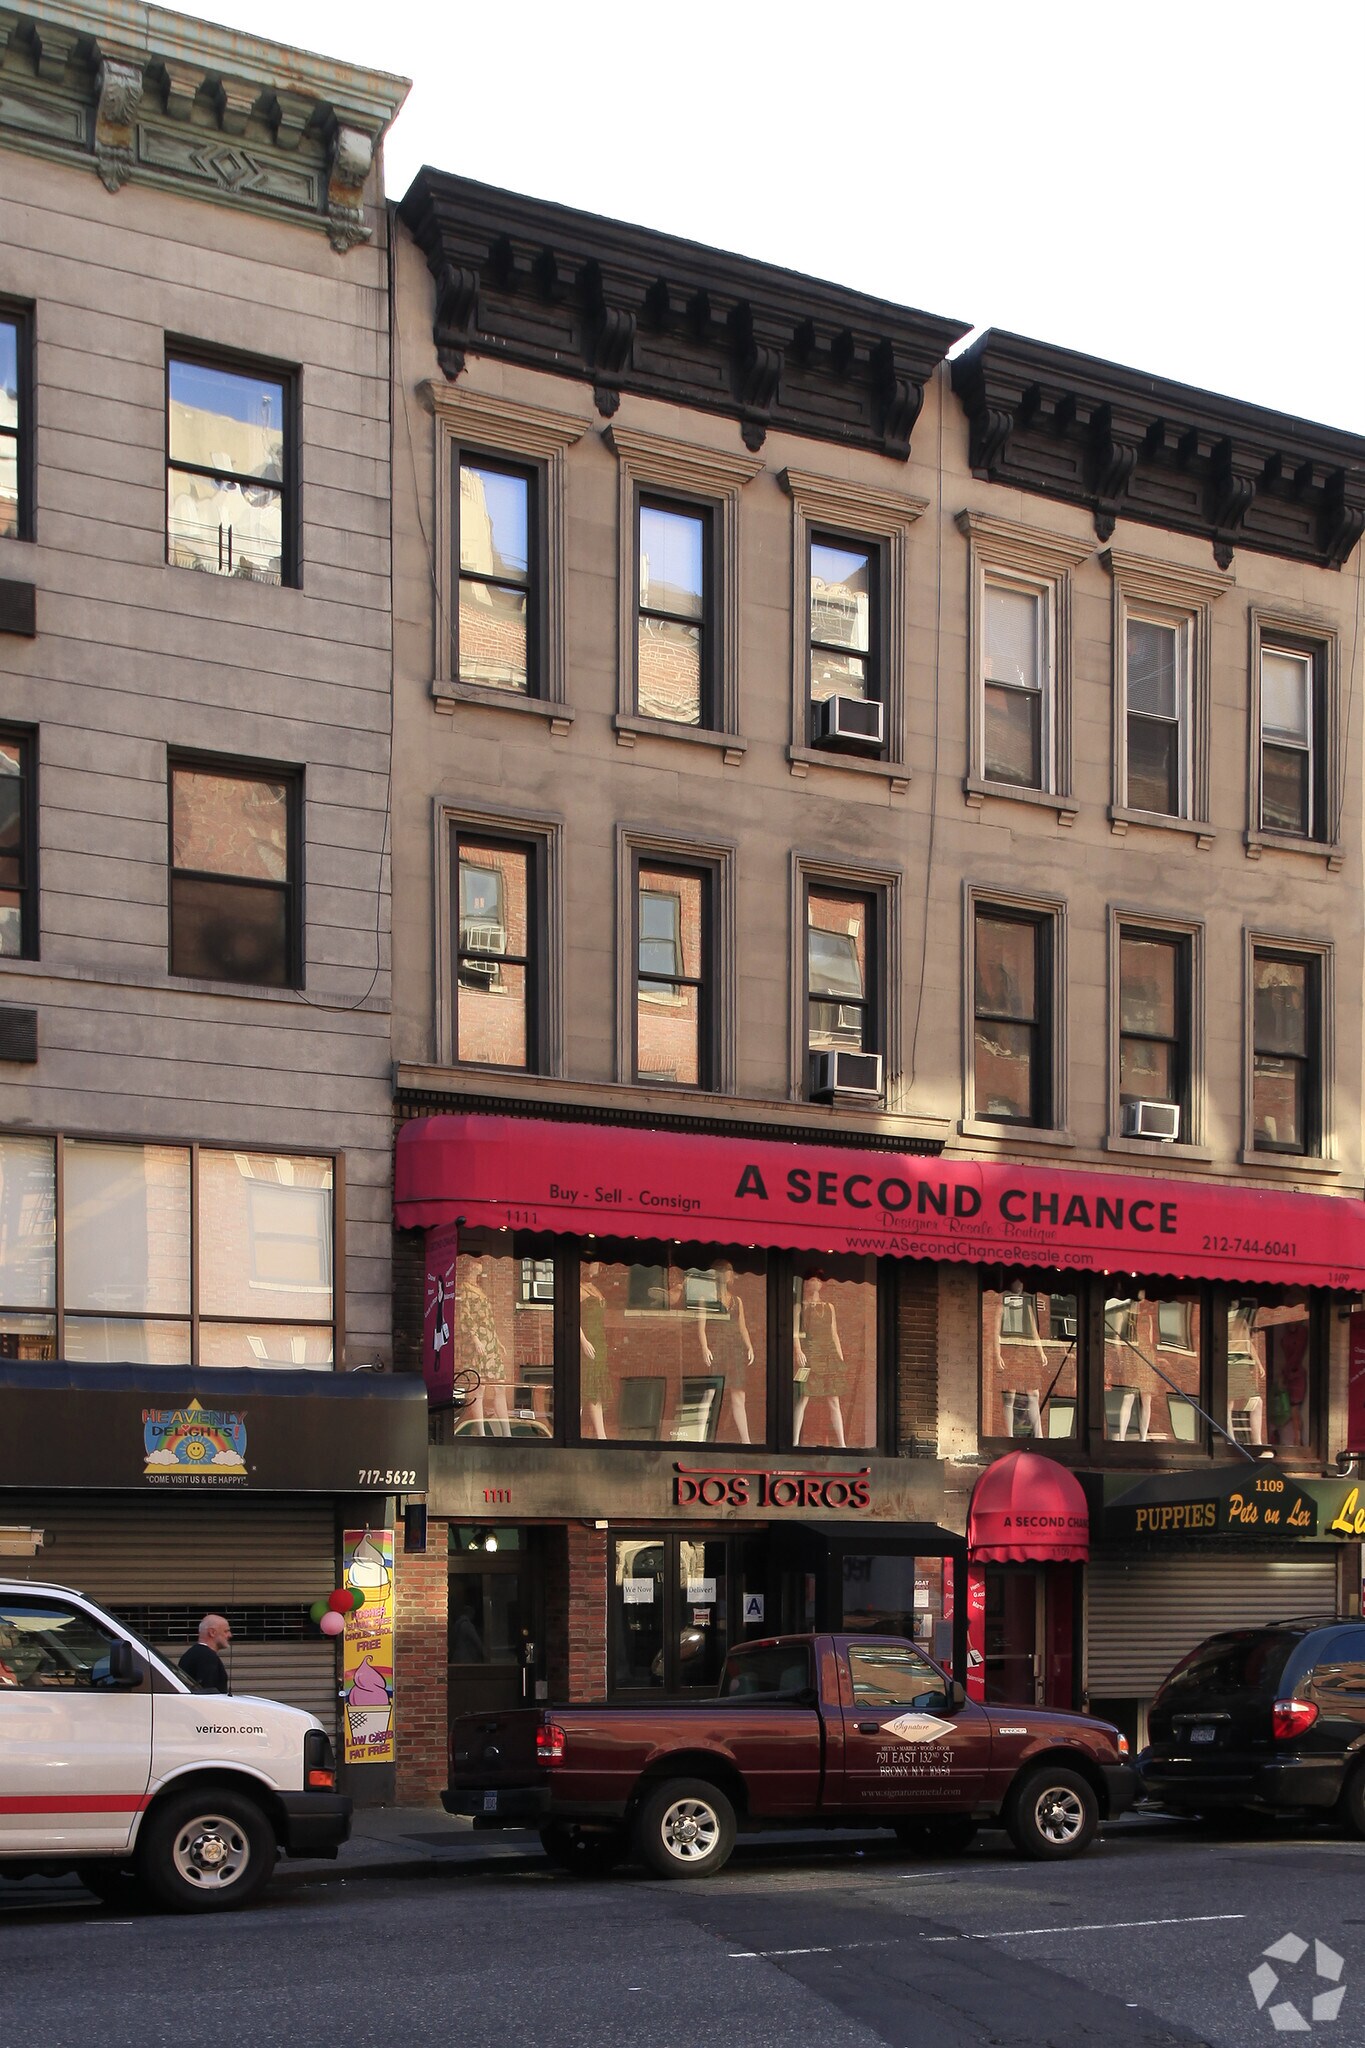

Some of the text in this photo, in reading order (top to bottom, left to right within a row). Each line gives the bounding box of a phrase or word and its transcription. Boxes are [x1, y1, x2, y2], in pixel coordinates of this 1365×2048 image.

[550, 1184, 579, 1204] Buy
[595, 1187, 622, 1203] Sell
[639, 1190, 701, 1212] Consign
[735, 1165, 1178, 1235] A SECOND CHANCE
[506, 1209, 538, 1225] 1111
[876, 1211, 1057, 1244] Designer Resale Boutique
[846, 1236, 1094, 1266] www.ASecondChanceResale.com
[1202, 1235, 1297, 1258] 212-744-6041
[142, 1408, 248, 1425] HEAVENLY
[152, 1424, 240, 1440] DELIGHTS!
[171, 1475, 189, 1484] VISIT
[190, 1475, 200, 1484] US
[208, 1476, 217, 1484] BE
[358, 1469, 416, 1485] 717-5622
[677, 1472, 871, 1508] DOS TOROS
[1255, 1479, 1284, 1493] 1109
[483, 1488, 511, 1503] 1111
[1135, 1503, 1217, 1532] PUPPIES
[1227, 1493, 1311, 1527] Pets on Lex
[1003, 1516, 1012, 1527] A
[1015, 1515, 1065, 1528] SECOND
[747, 1597, 761, 1615] A
[356, 1639, 381, 1652] FREE
[195, 1724, 264, 1734] verizon.com
[893, 1720, 930, 1734] Signature
[346, 1734, 367, 1747] LOW
[349, 1743, 390, 1759] FAT FREE
[876, 1752, 888, 1763] 791
[892, 1752, 917, 1763] EAST
[943, 1752, 955, 1763] ST
[880, 1766, 909, 1777] BRONX
[861, 1787, 961, 1799] www.signaturemetal.com
